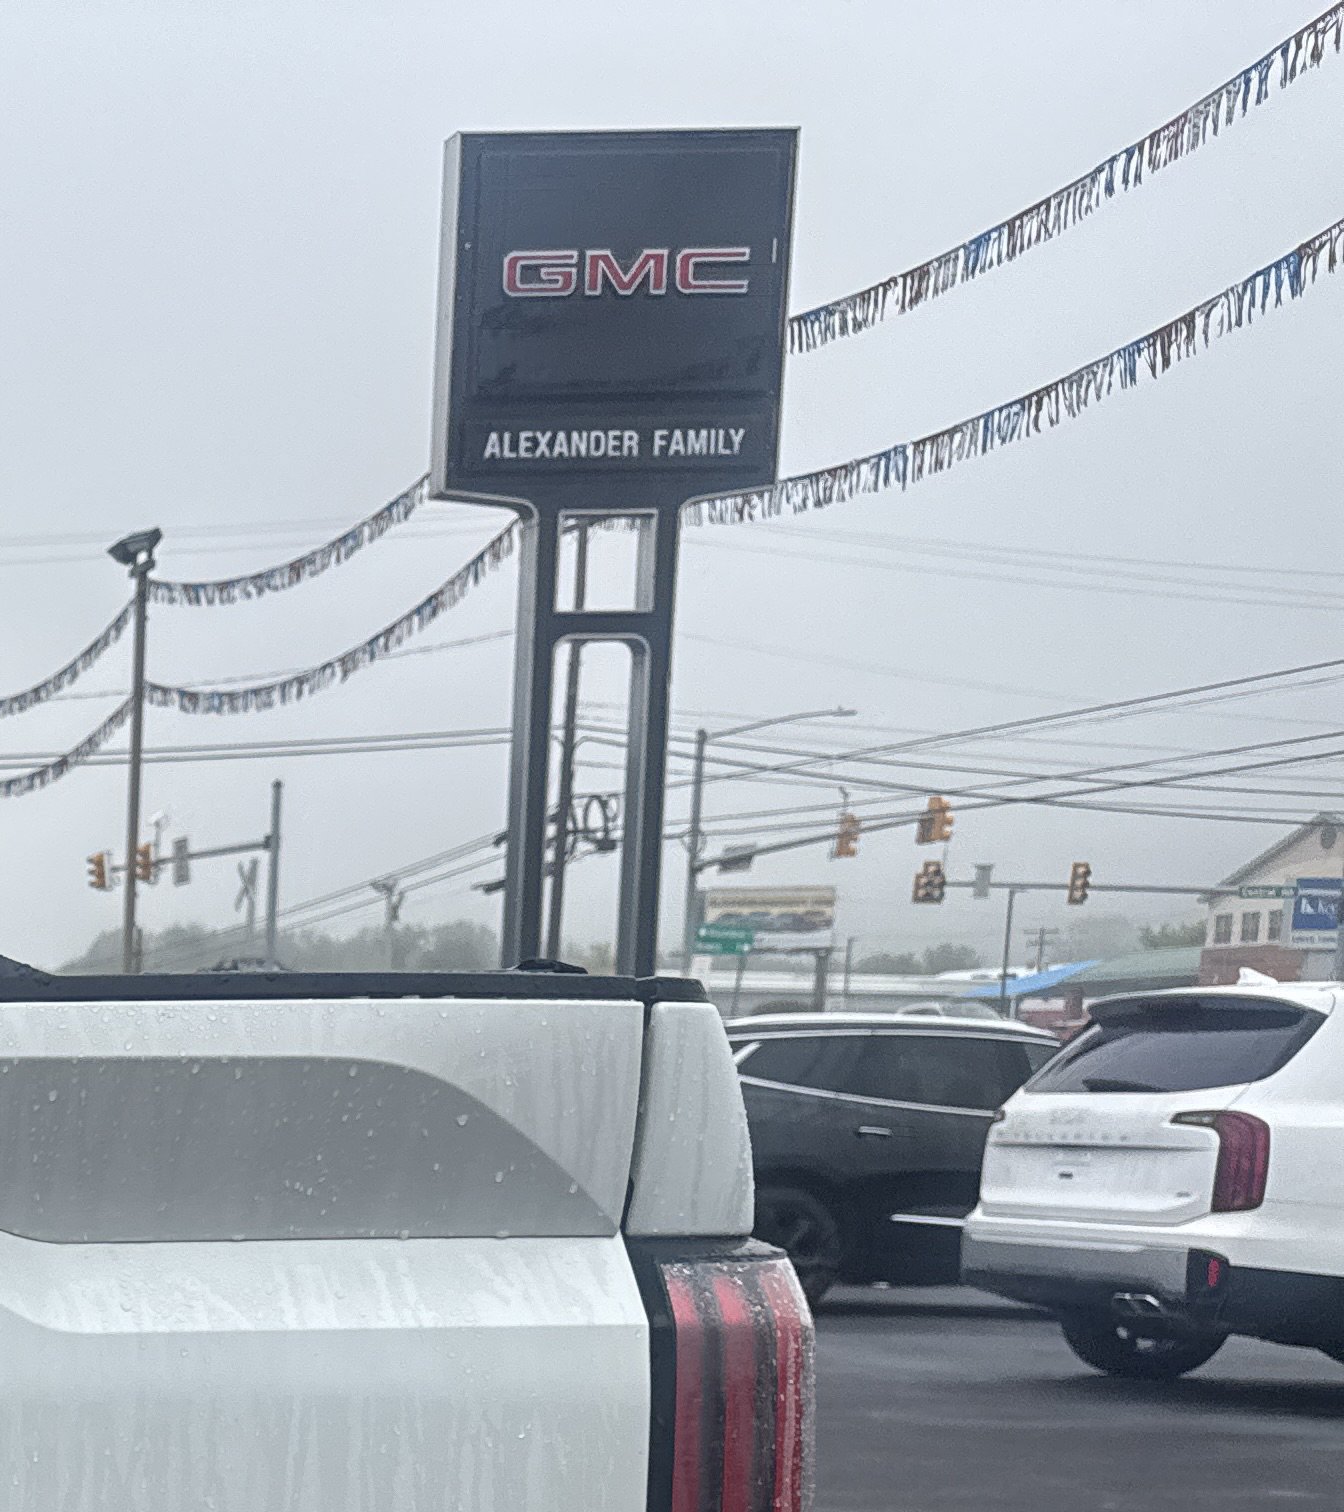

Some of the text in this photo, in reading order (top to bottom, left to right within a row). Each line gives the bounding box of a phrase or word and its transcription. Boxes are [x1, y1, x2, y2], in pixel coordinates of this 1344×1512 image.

[503, 247, 751, 297] GMC
[484, 427, 746, 460] ALEXANDER FAMILY
